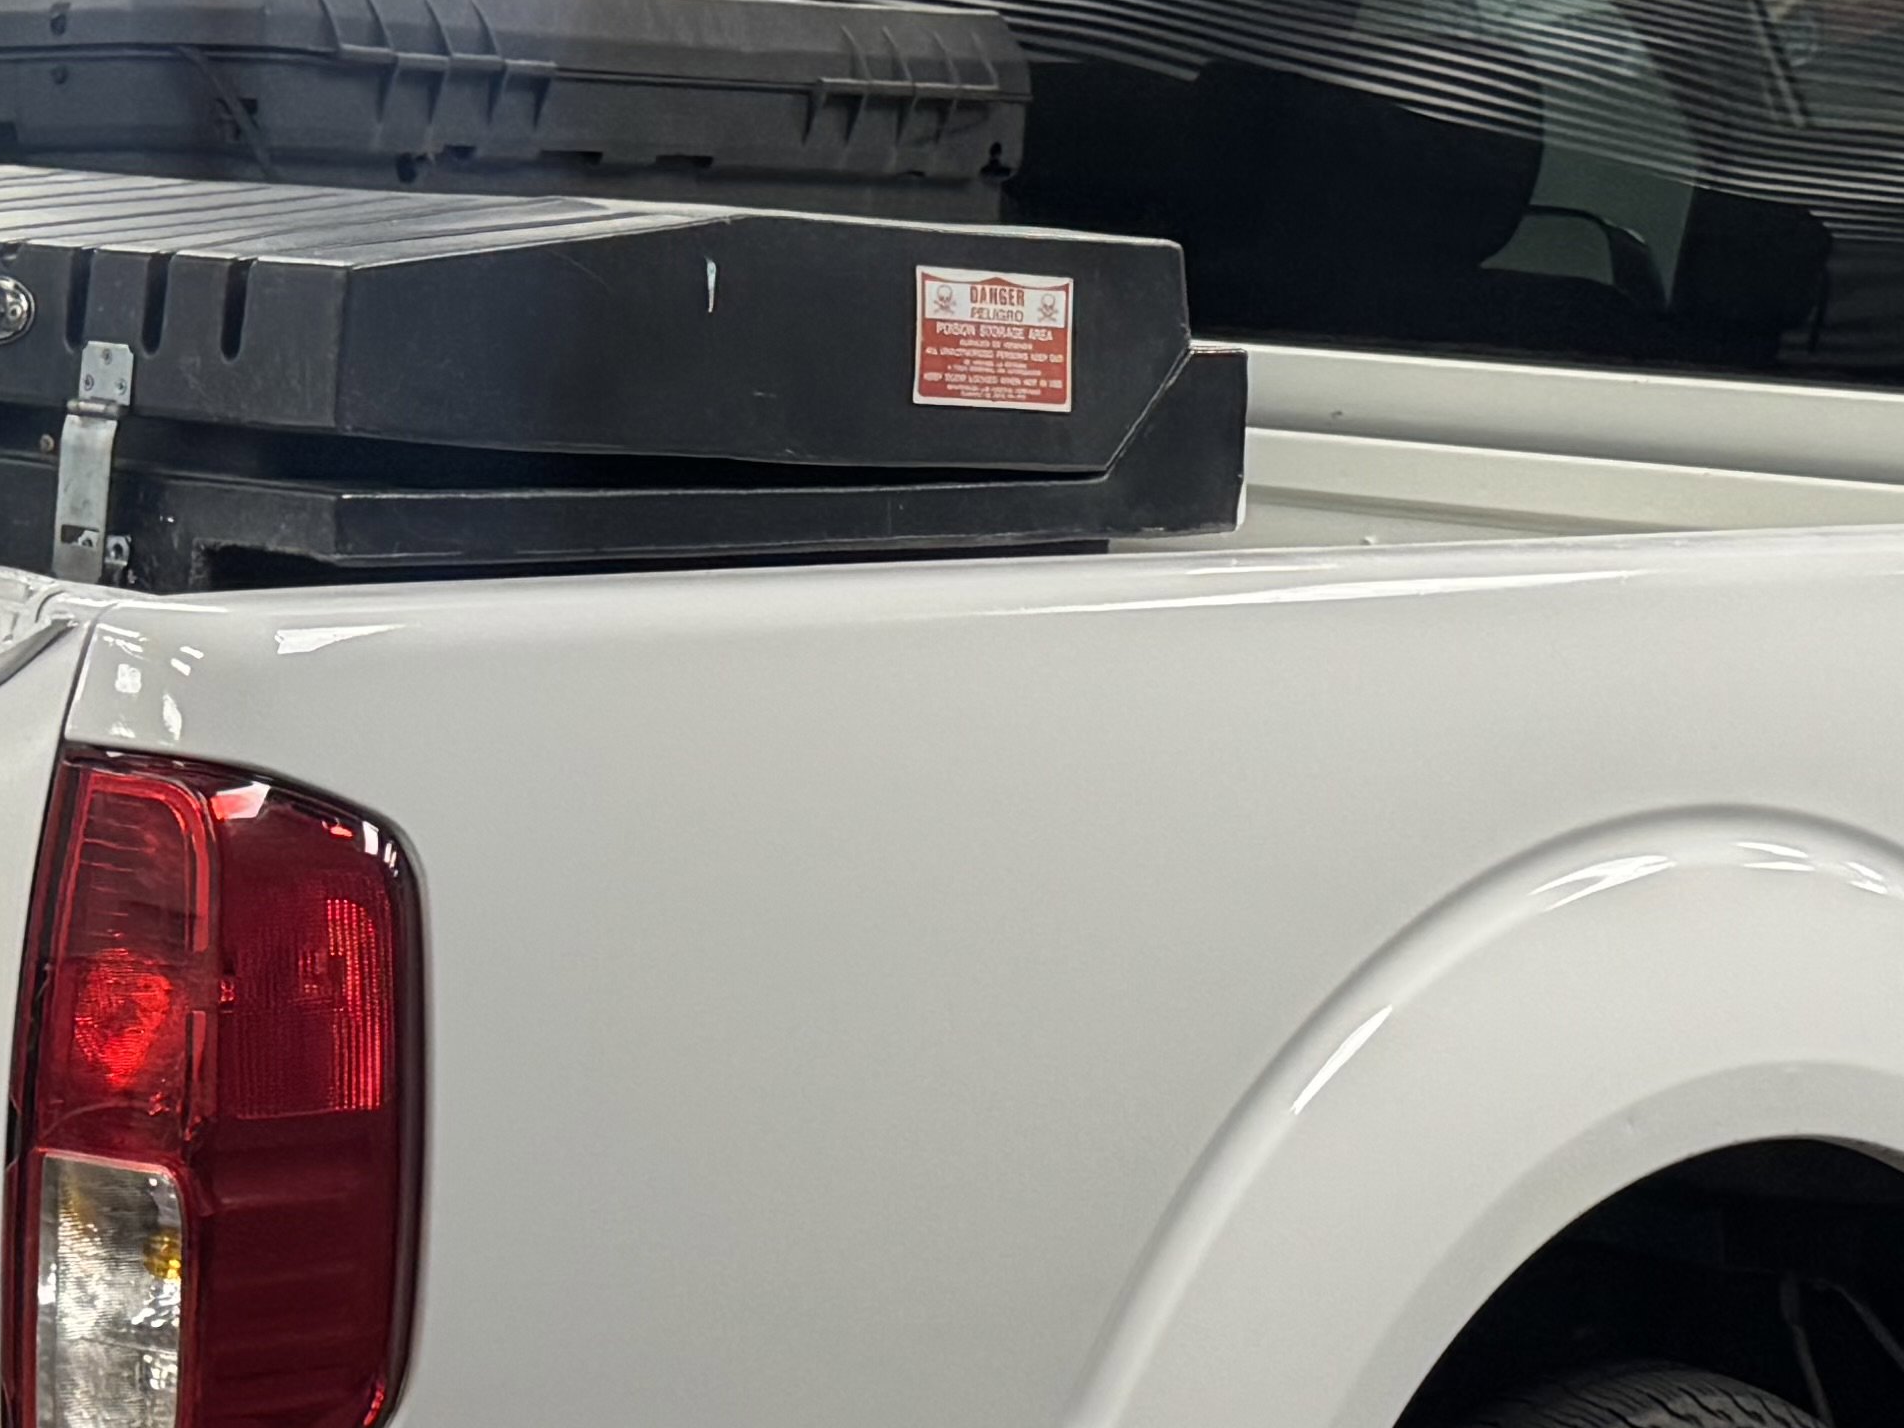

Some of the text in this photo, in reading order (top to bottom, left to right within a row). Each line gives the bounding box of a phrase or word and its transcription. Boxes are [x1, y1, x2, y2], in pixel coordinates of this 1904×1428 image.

[970, 285, 1025, 306] DANGER
[971, 306, 1024, 322] PELIGRO
[936, 322, 1053, 341] POISON STORAGE AREA
